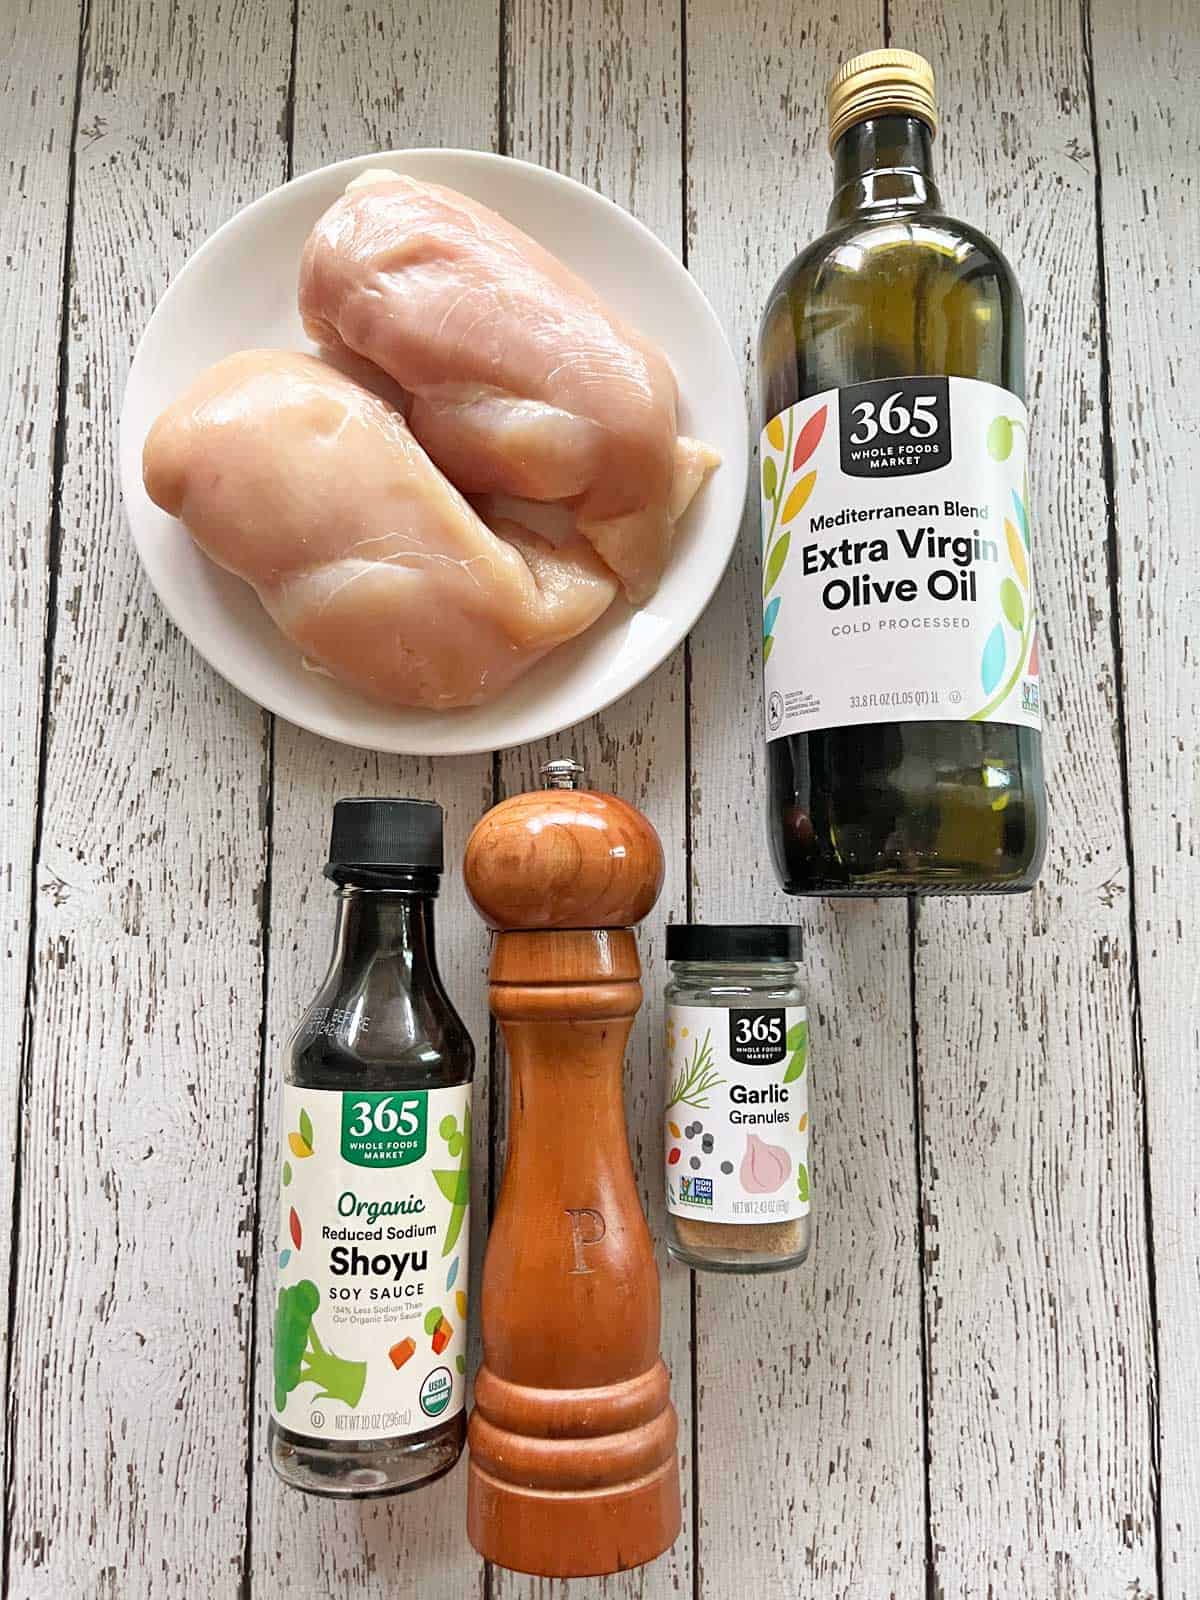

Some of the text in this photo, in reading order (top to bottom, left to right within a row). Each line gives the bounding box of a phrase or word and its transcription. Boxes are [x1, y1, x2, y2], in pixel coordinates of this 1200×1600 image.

[850, 391, 939, 445] 365
[851, 444, 940, 461] WHOLE FOODS
[869, 456, 921, 469] MARKET
[809, 500, 989, 533] Mediterranean Blend
[802, 526, 999, 576] Extra Virgin
[822, 569, 977, 611] Olive Oil
[831, 617, 971, 637] COLD PROCESSED
[879, 692, 890, 705] OZ
[735, 1015, 781, 1044] 365
[730, 1084, 790, 1105] Garlic
[350, 1096, 419, 1137] 365
[729, 1109, 790, 1125] Granules
[350, 1141, 418, 1150] WHOLE FOODS
[364, 1151, 404, 1159] MARKET
[337, 1191, 426, 1225] Organic
[322, 1224, 437, 1241] Reduced Sodium
[564, 1208, 606, 1274] P
[329, 1246, 428, 1281] Shoyu
[329, 1283, 424, 1300] SOY SAUCE
[373, 1303, 403, 1314] Sodium
[333, 1314, 348, 1324] Our
[349, 1315, 382, 1325] Organic
[335, 1415, 348, 1430] NET
[348, 1415, 360, 1430] WT
[371, 1414, 381, 1430] OZ
